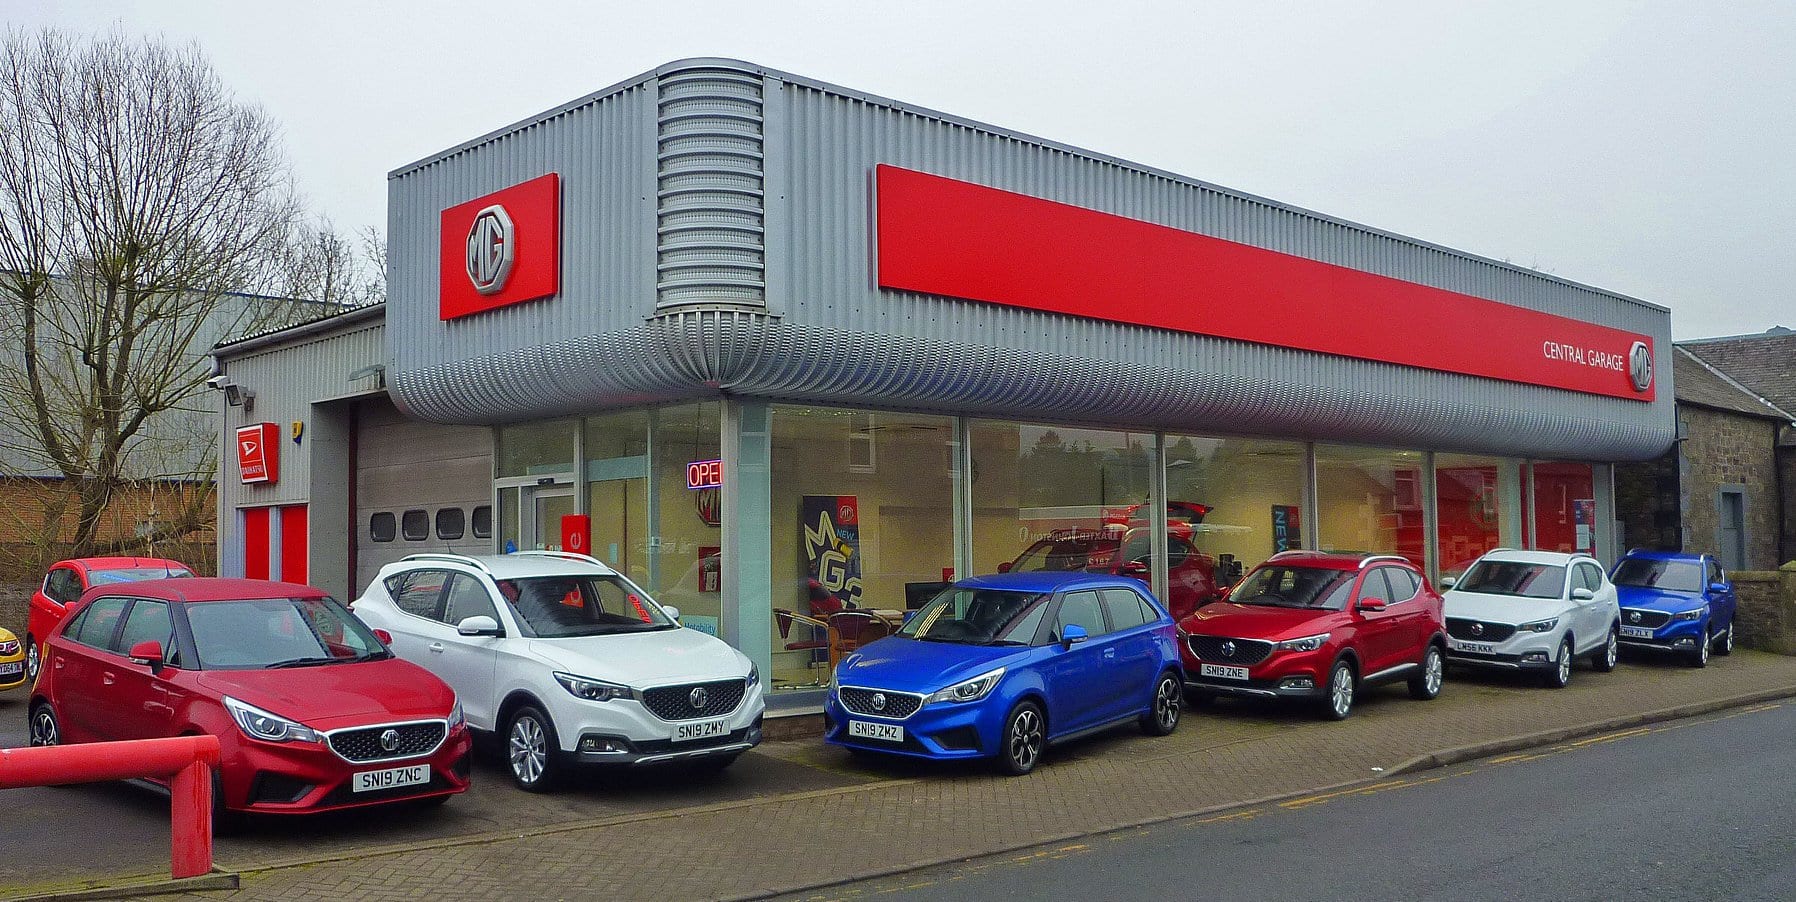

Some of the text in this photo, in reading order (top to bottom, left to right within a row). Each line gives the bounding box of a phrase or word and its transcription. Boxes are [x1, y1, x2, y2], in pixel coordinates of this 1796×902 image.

[467, 211, 507, 286] MG
[1543, 341, 1624, 371] CENTRAL GARAGE
[837, 529, 855, 541] NEW
[1206, 666, 1243, 677] SN19 ZNE
[679, 721, 724, 738] SN19 ZMY
[855, 723, 897, 738] SN19 ZMZ
[363, 768, 422, 787] SN19 ZNC
